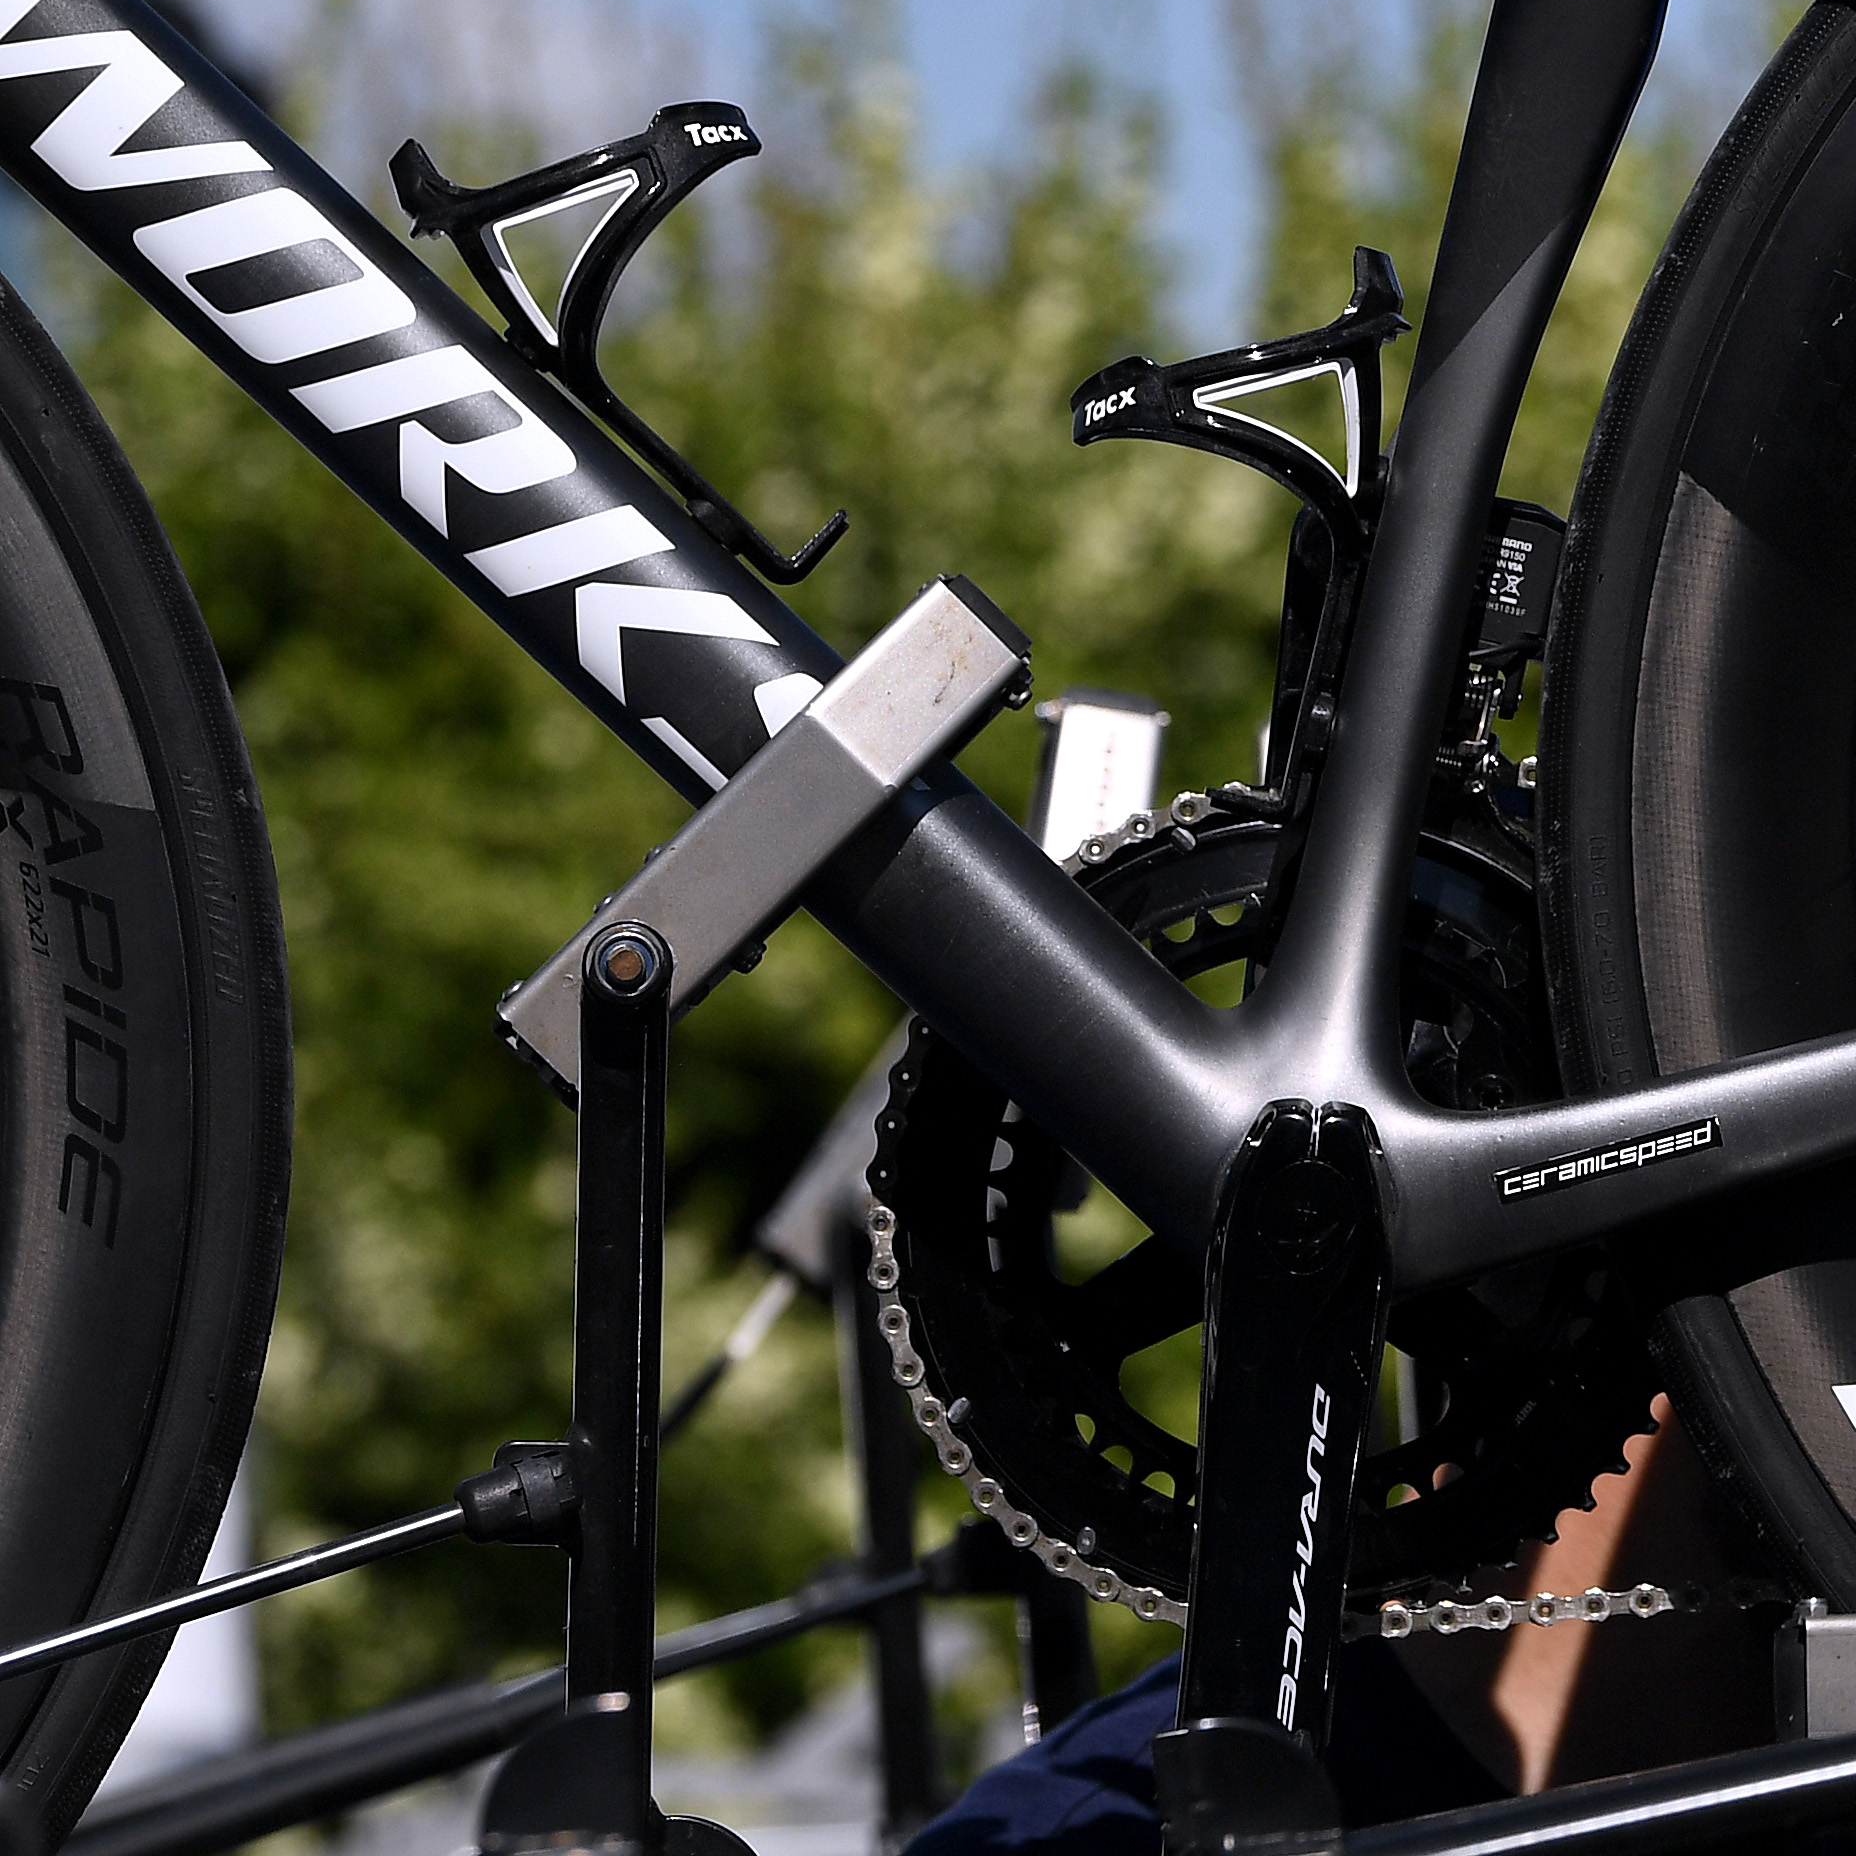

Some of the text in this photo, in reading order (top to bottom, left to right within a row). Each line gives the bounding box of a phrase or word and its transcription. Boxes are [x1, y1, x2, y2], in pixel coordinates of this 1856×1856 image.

[684, 122, 748, 147] Tacx
[1084, 386, 1136, 426] Tacx
[18, 862, 50, 958] 622x21
[0, 678, 130, 1250] RAPIDE
[1504, 1120, 1714, 1197] ceramicspeed
[1277, 1383, 1331, 1732] DURA-ACE
